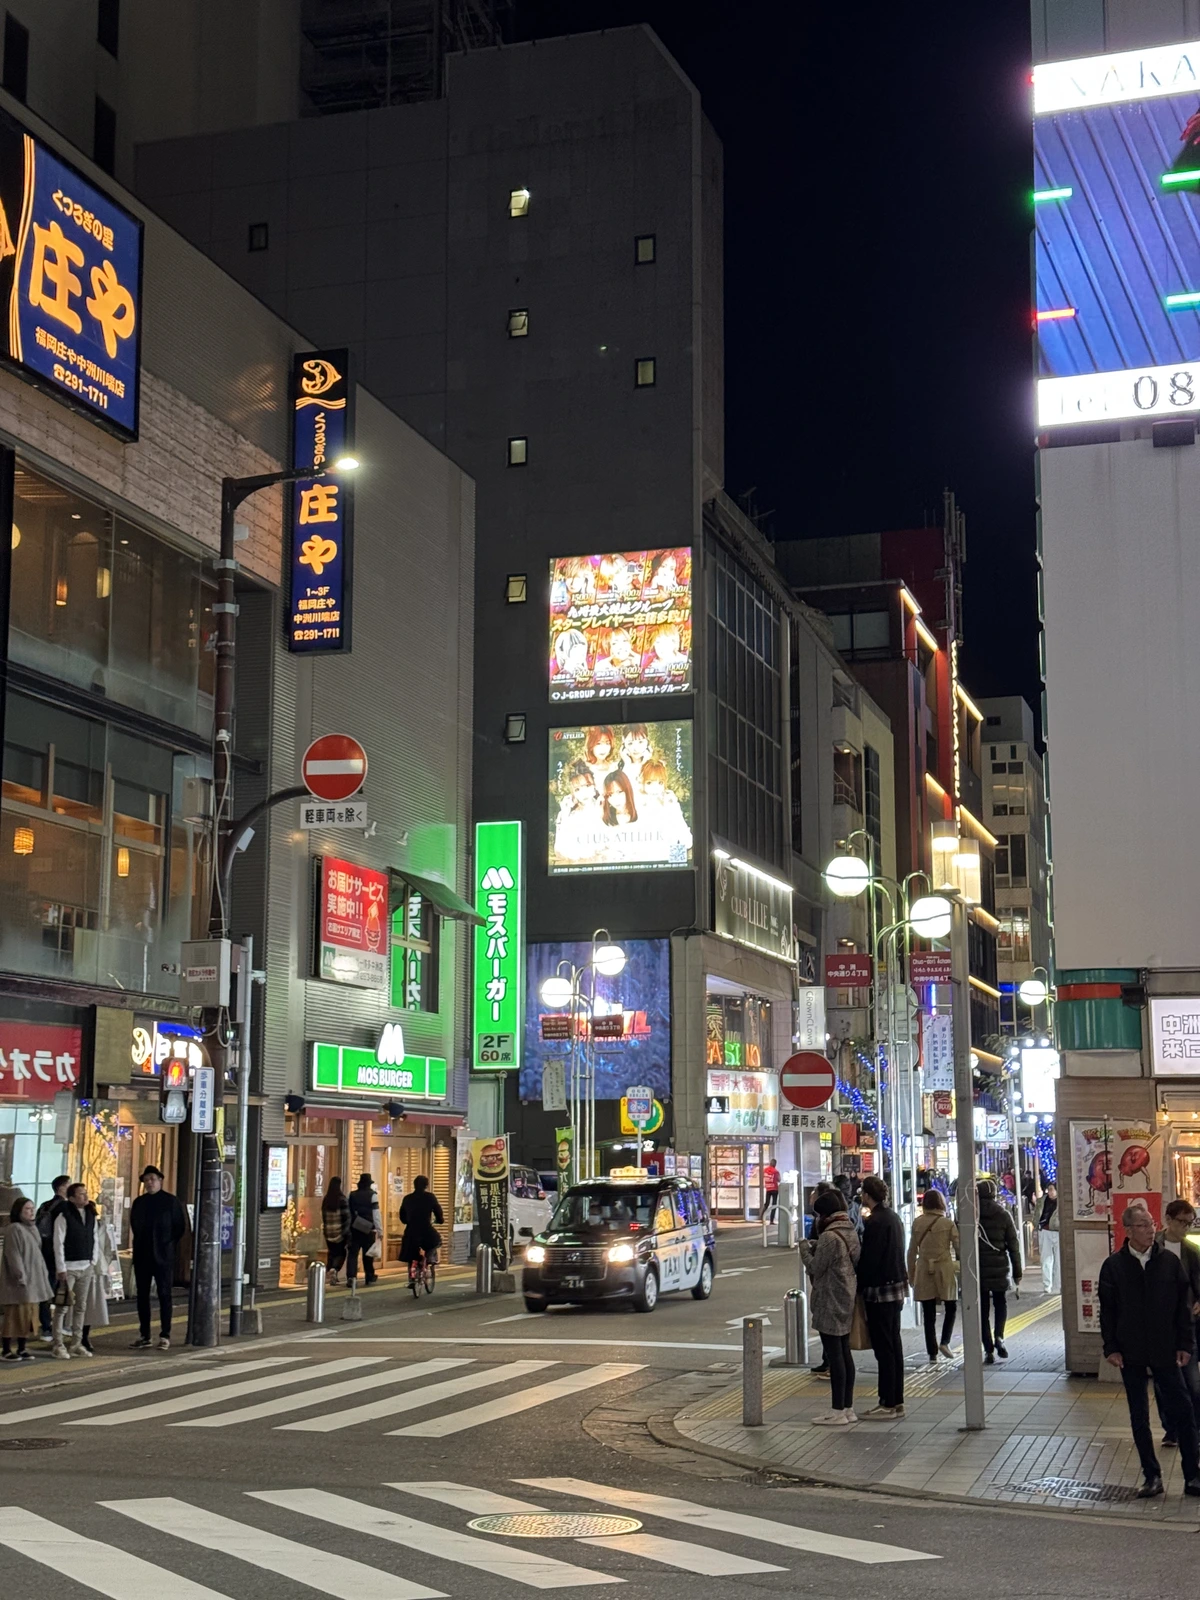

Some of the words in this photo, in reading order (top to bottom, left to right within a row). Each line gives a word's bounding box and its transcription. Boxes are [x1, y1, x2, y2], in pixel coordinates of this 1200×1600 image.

[52, 189, 114, 251] くつろぎの里
[28, 220, 136, 359] 庄や
[35, 326, 125, 398] 福岡庄や中洲川端店
[299, 483, 338, 575] 庄や
[298, 598, 336, 610] 福岡庄や
[293, 611, 340, 624] 中洲川端店
[305, 807, 363, 824] 軽車両を除く
[327, 869, 385, 904] お届けサービス
[327, 892, 364, 920] 実施中!!
[485, 892, 508, 1022] モスバーガー
[482, 1035, 511, 1048] 2F
[481, 1050, 511, 1062] 60席
[357, 1066, 379, 1086] MOS
[379, 1068, 413, 1088] BURGER
[200, 1071, 209, 1129] 歩車分離信号
[782, 1113, 833, 1129] 軽車両を除く
[663, 1255, 681, 1278] TAXI
